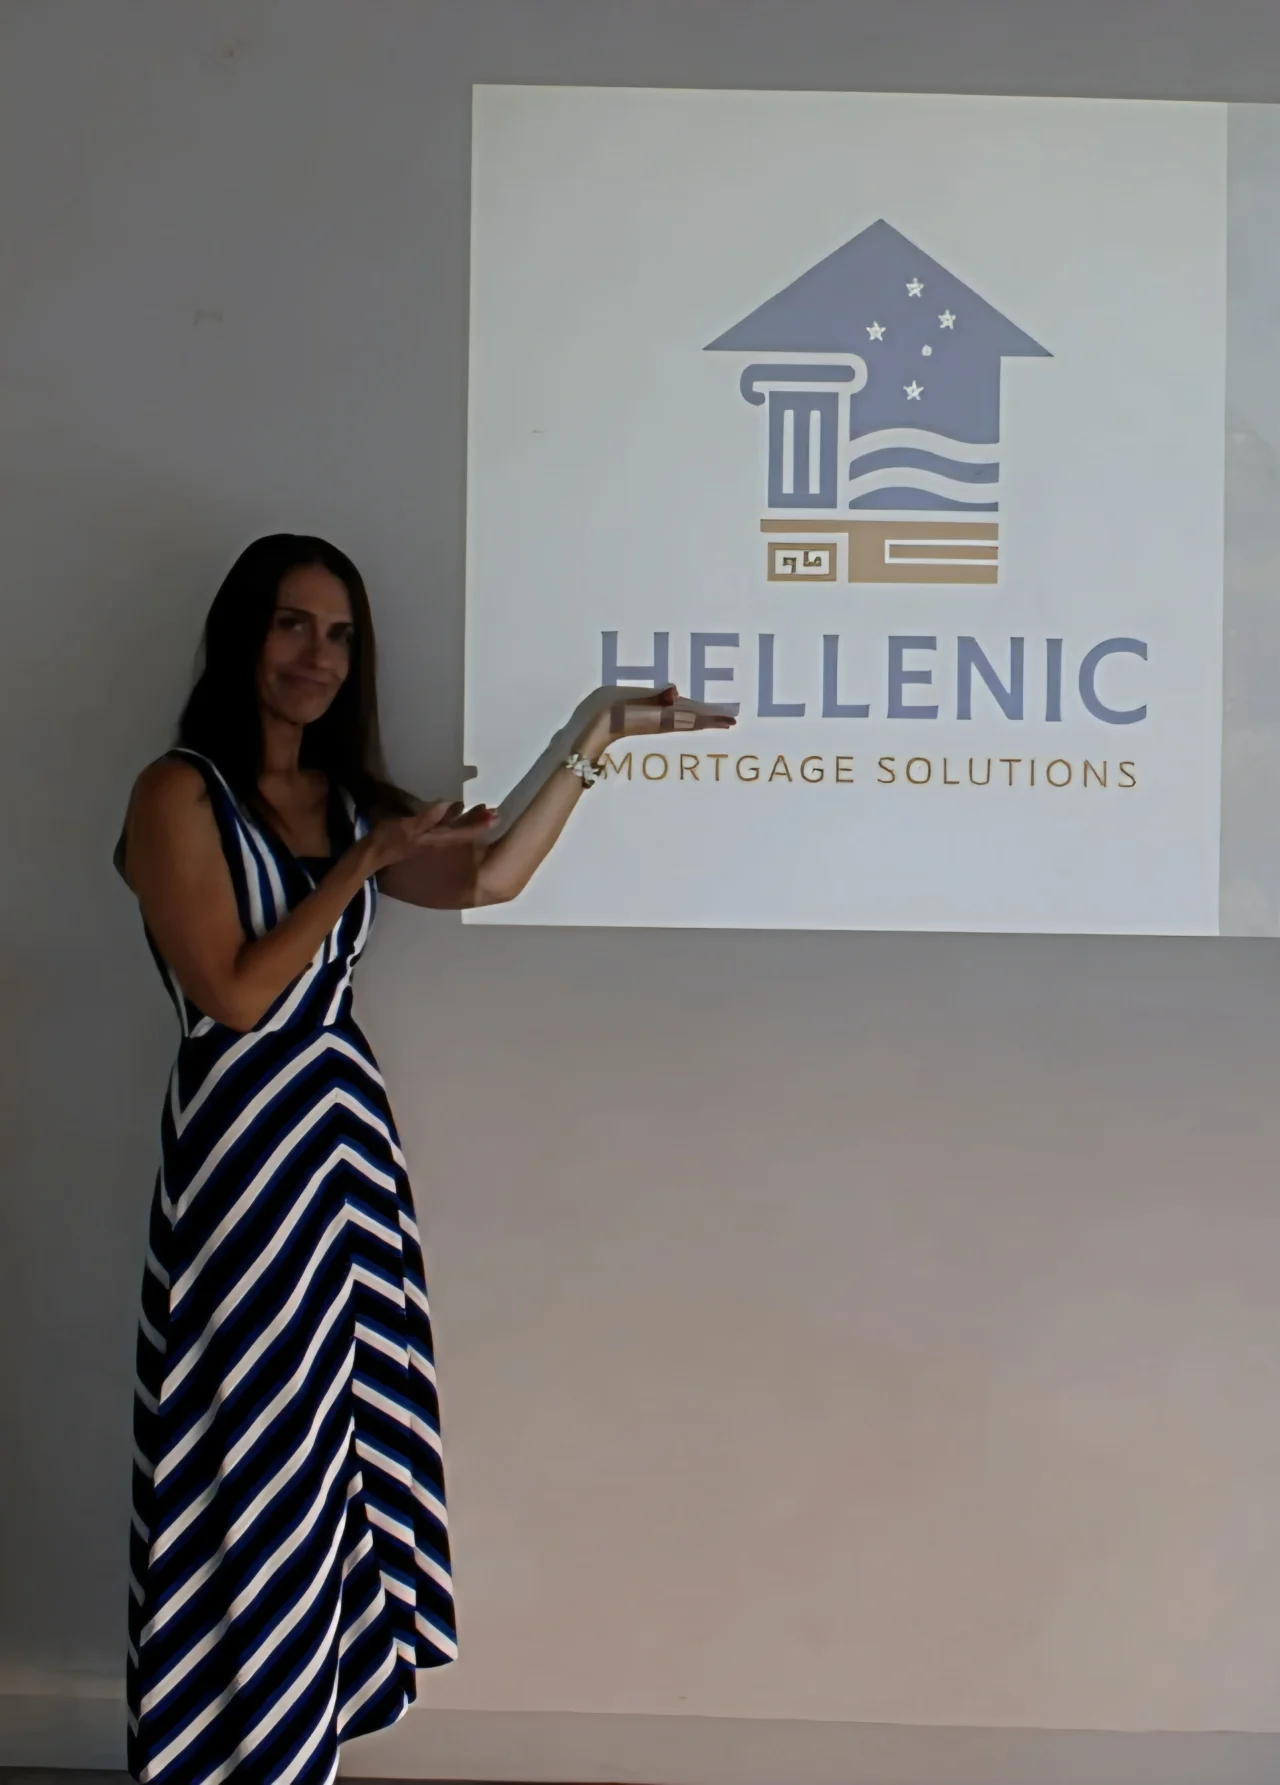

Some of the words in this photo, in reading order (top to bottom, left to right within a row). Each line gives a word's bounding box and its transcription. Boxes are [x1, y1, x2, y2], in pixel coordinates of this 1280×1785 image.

[600, 630, 1149, 726] HELLENIC
[601, 751, 855, 785] MORTGAGE
[876, 755, 1138, 789] SOLUTIONS
